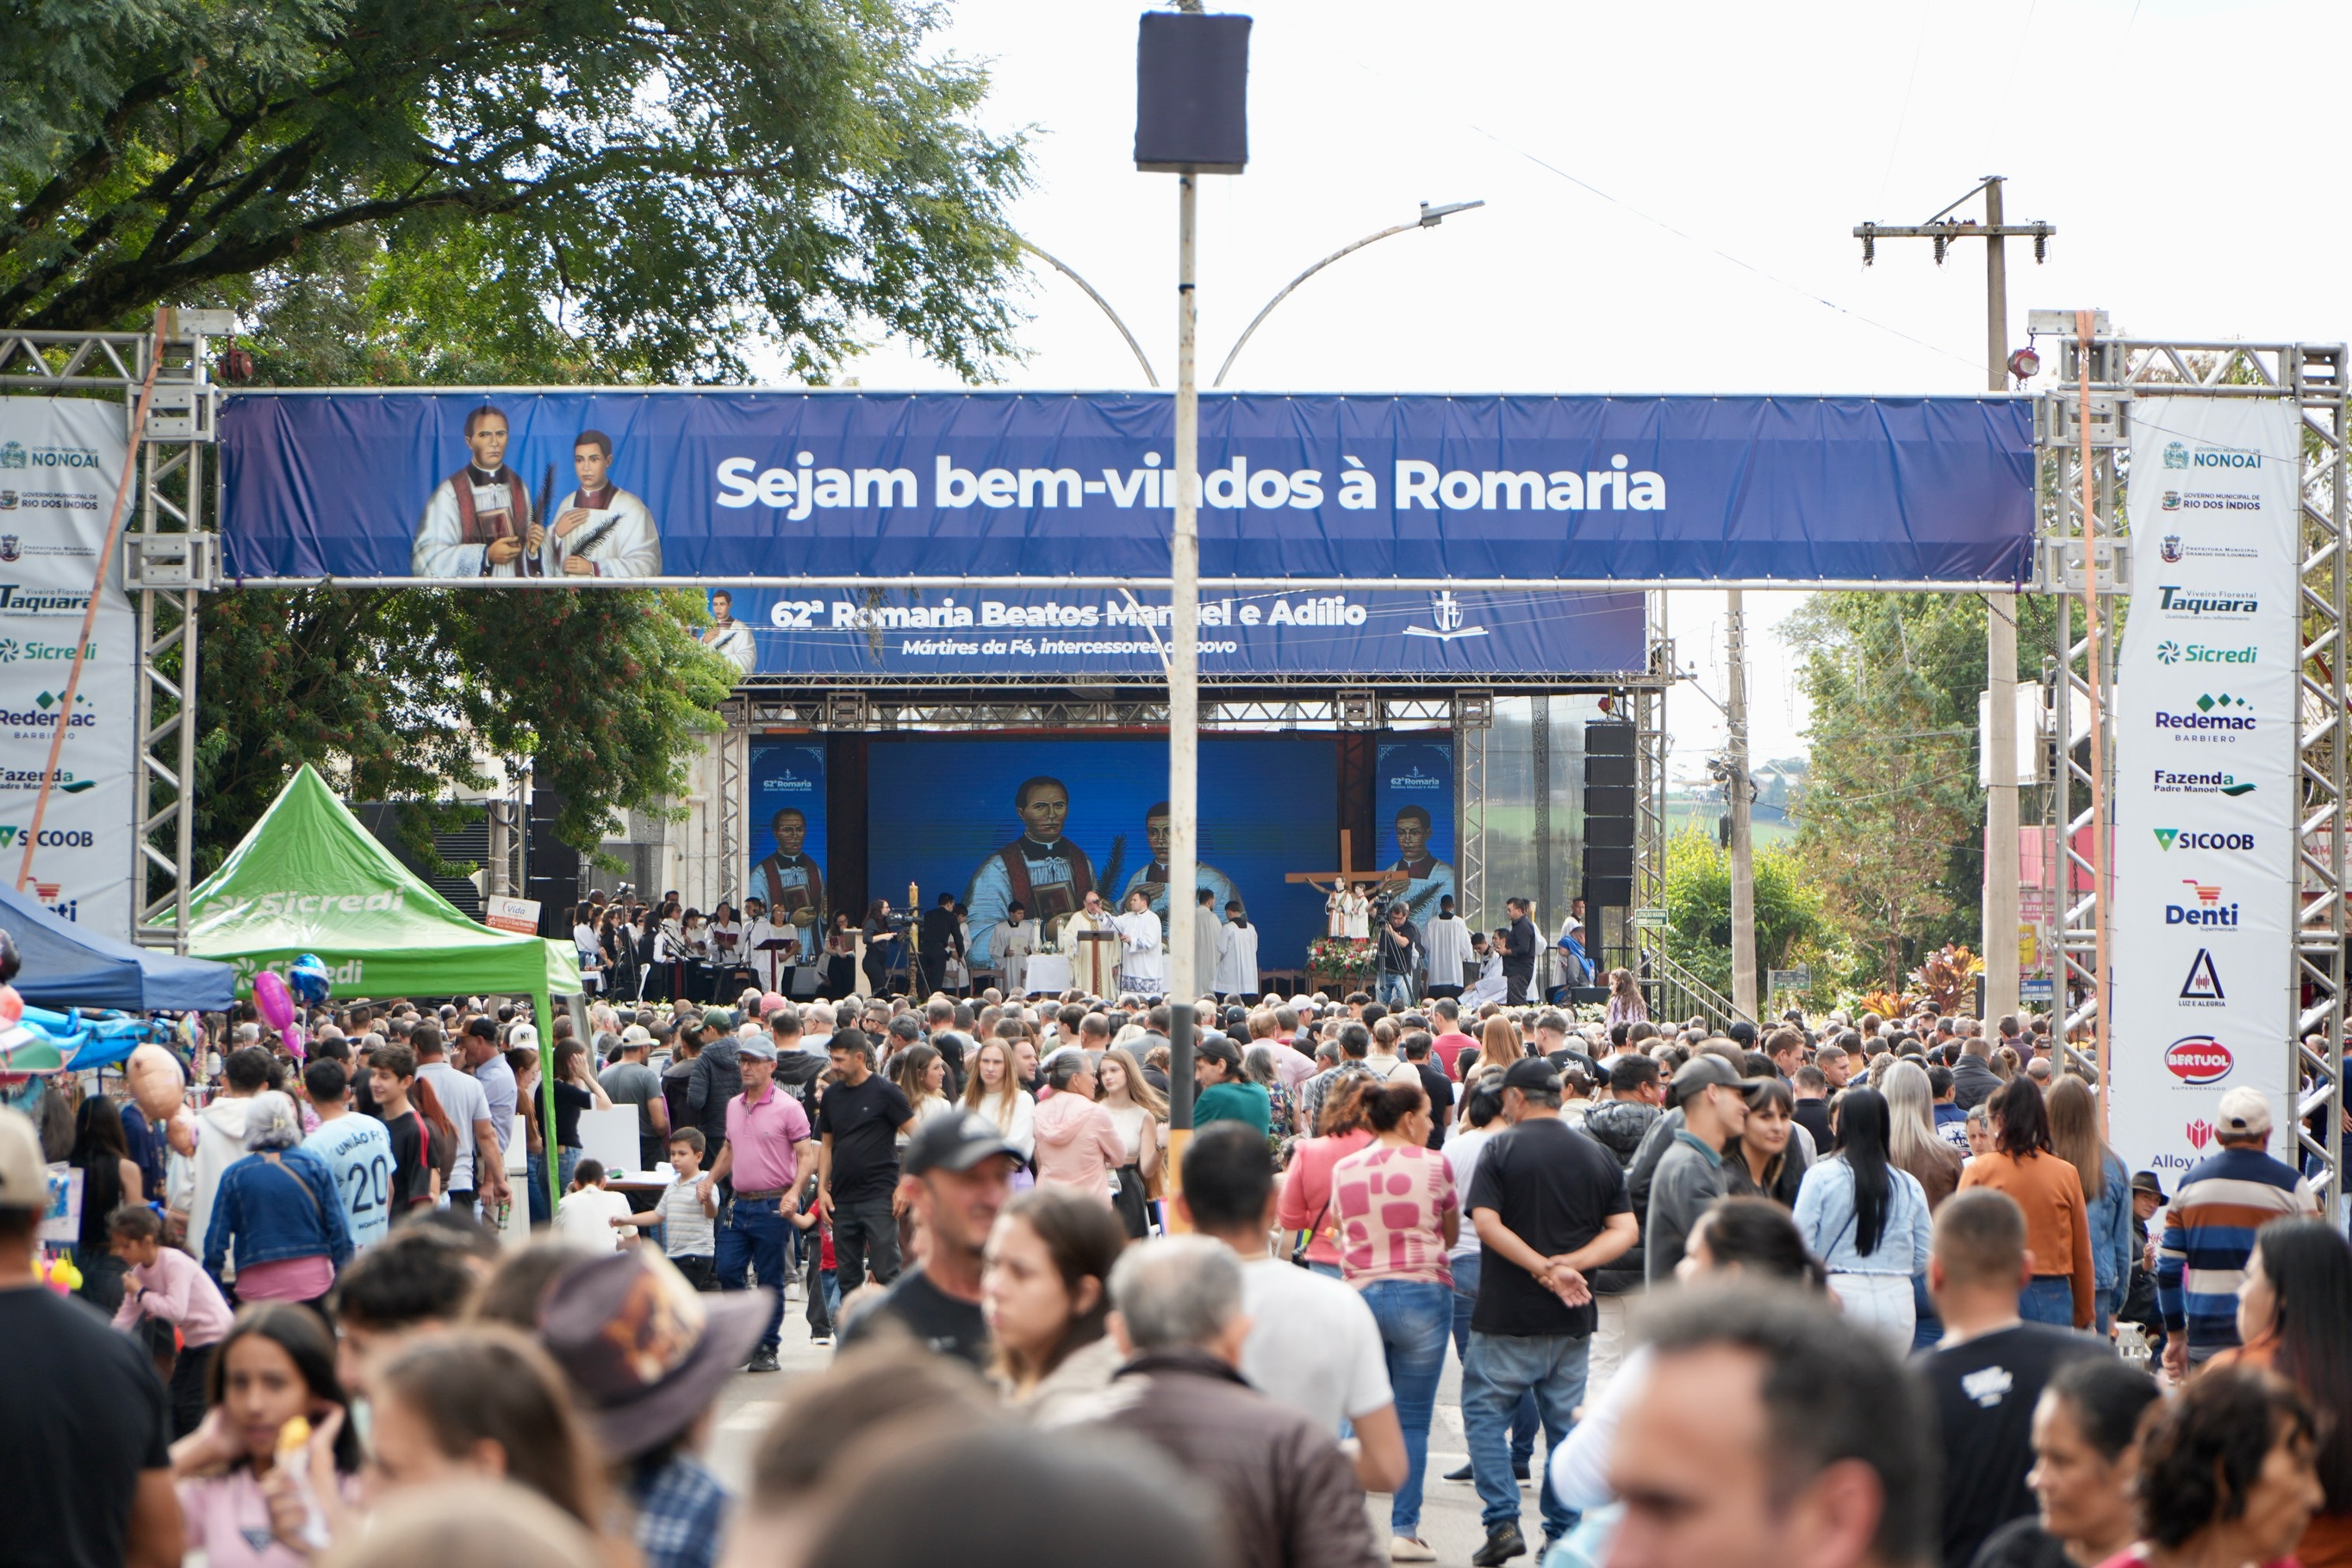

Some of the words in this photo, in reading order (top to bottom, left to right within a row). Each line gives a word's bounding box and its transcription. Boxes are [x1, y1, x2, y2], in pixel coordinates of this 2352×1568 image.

[33, 453, 99, 468] NONOAI
[2194, 453, 2262, 469] NONOAI
[717, 451, 917, 521] Sejam
[1338, 455, 1376, 510] à
[1395, 453, 1666, 511] Romaria
[41, 500, 61, 508] DOS
[64, 499, 97, 510] ÍNDIOS
[2226, 500, 2260, 510] ÍNDIOS
[2158, 586, 2258, 615] Taquara
[771, 600, 824, 628] 62ª
[832, 597, 974, 628] Romaria
[981, 600, 1099, 627] Beatos
[1107, 599, 1232, 626] Manel
[1240, 606, 1261, 626] e
[1267, 595, 1367, 626] Adílio
[902, 638, 979, 656] Mártires
[982, 639, 1007, 656] da
[1010, 638, 1037, 657] Fé,
[1040, 638, 1158, 655] intercessores
[2185, 644, 2257, 663] Sicredi
[2156, 712, 2256, 731] Redemac
[2155, 770, 2234, 785] Fazenda
[18, 830, 93, 847] SCOOB
[2179, 832, 2255, 850] SICOOB
[256, 887, 405, 916] Sicredi
[507, 905, 525, 914] Vida
[2166, 903, 2238, 925] Denti
[266, 960, 364, 984] Siedi
[2168, 1055, 2230, 1067] BERTUOL
[335, 1132, 369, 1156] UNIÃO
[2151, 1154, 2194, 1172] Alloy
[348, 1154, 388, 1215] 20
